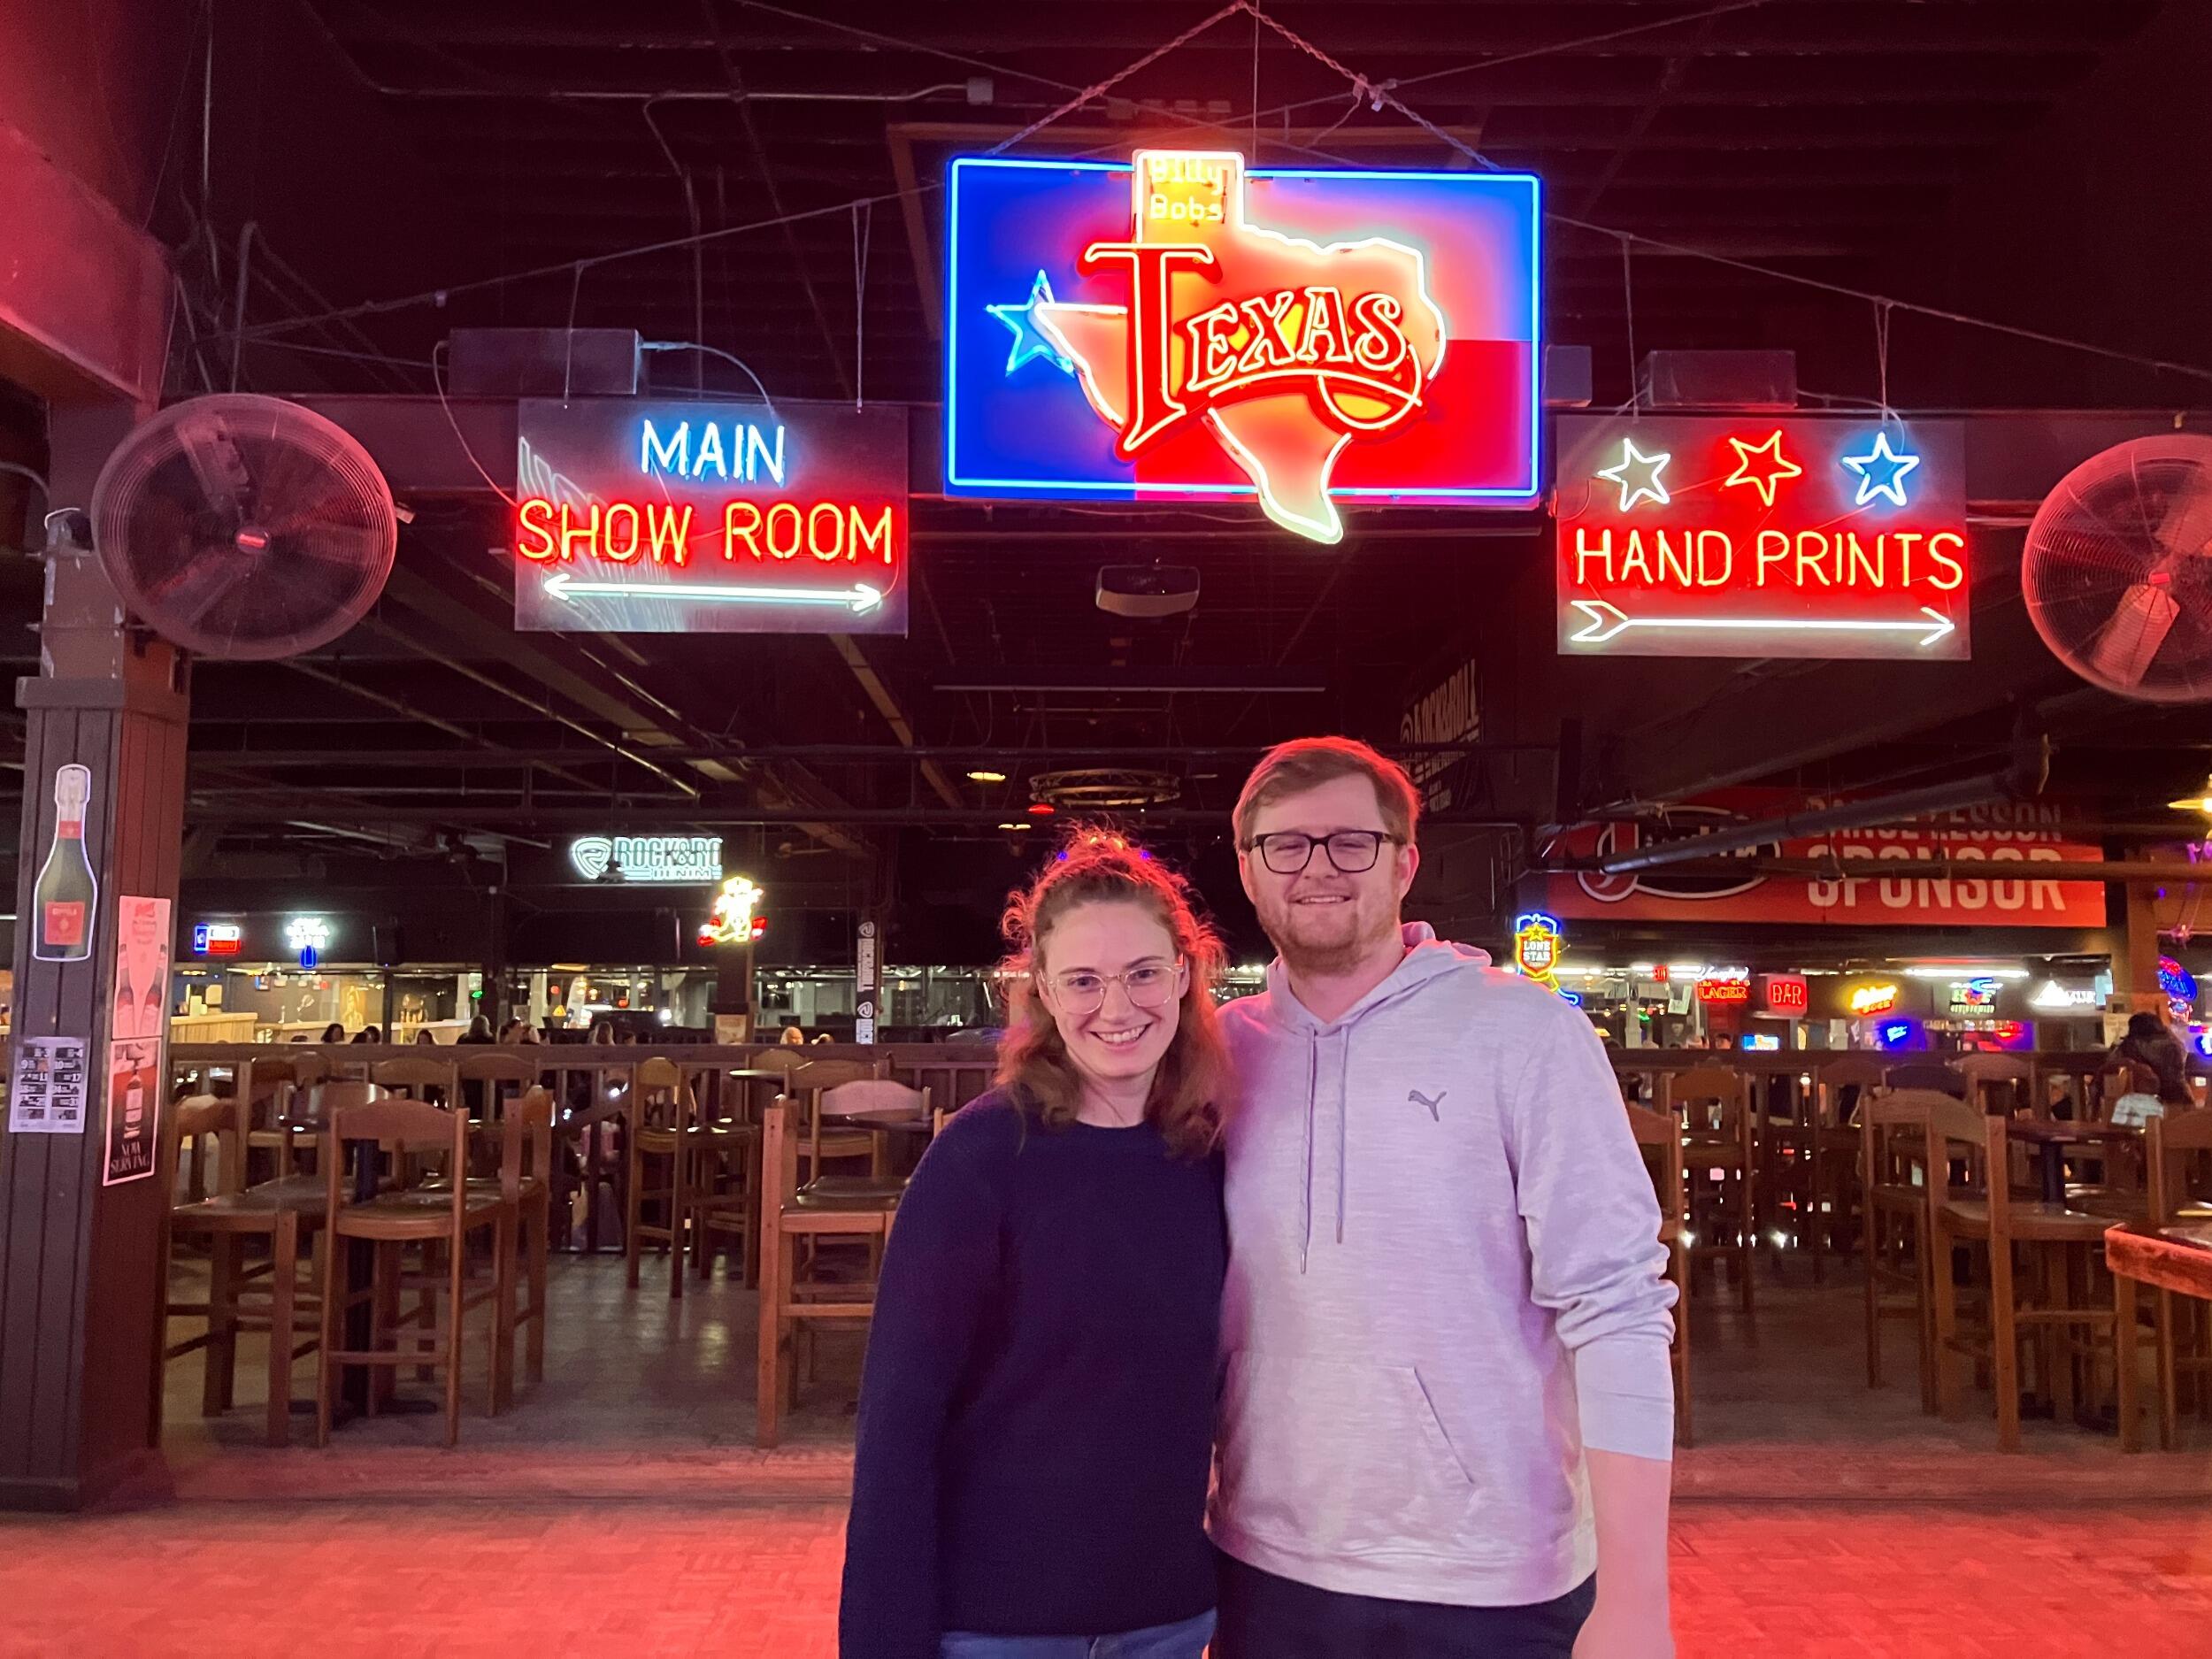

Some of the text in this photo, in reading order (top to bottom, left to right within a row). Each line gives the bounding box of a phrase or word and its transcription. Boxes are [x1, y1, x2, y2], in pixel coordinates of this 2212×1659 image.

[1149, 157, 1225, 195] Billy
[641, 419, 786, 485] MAIN
[518, 499, 893, 565] SHOW ROOM
[1575, 528, 1965, 591] HAND PRINTS
[1807, 843, 2067, 910] SPONSOR
[1523, 941, 1551, 951] LONE
[1523, 951, 1551, 962] STAR
[1699, 986, 1747, 1000] LAGER
[1771, 983, 1802, 1005] BAR
